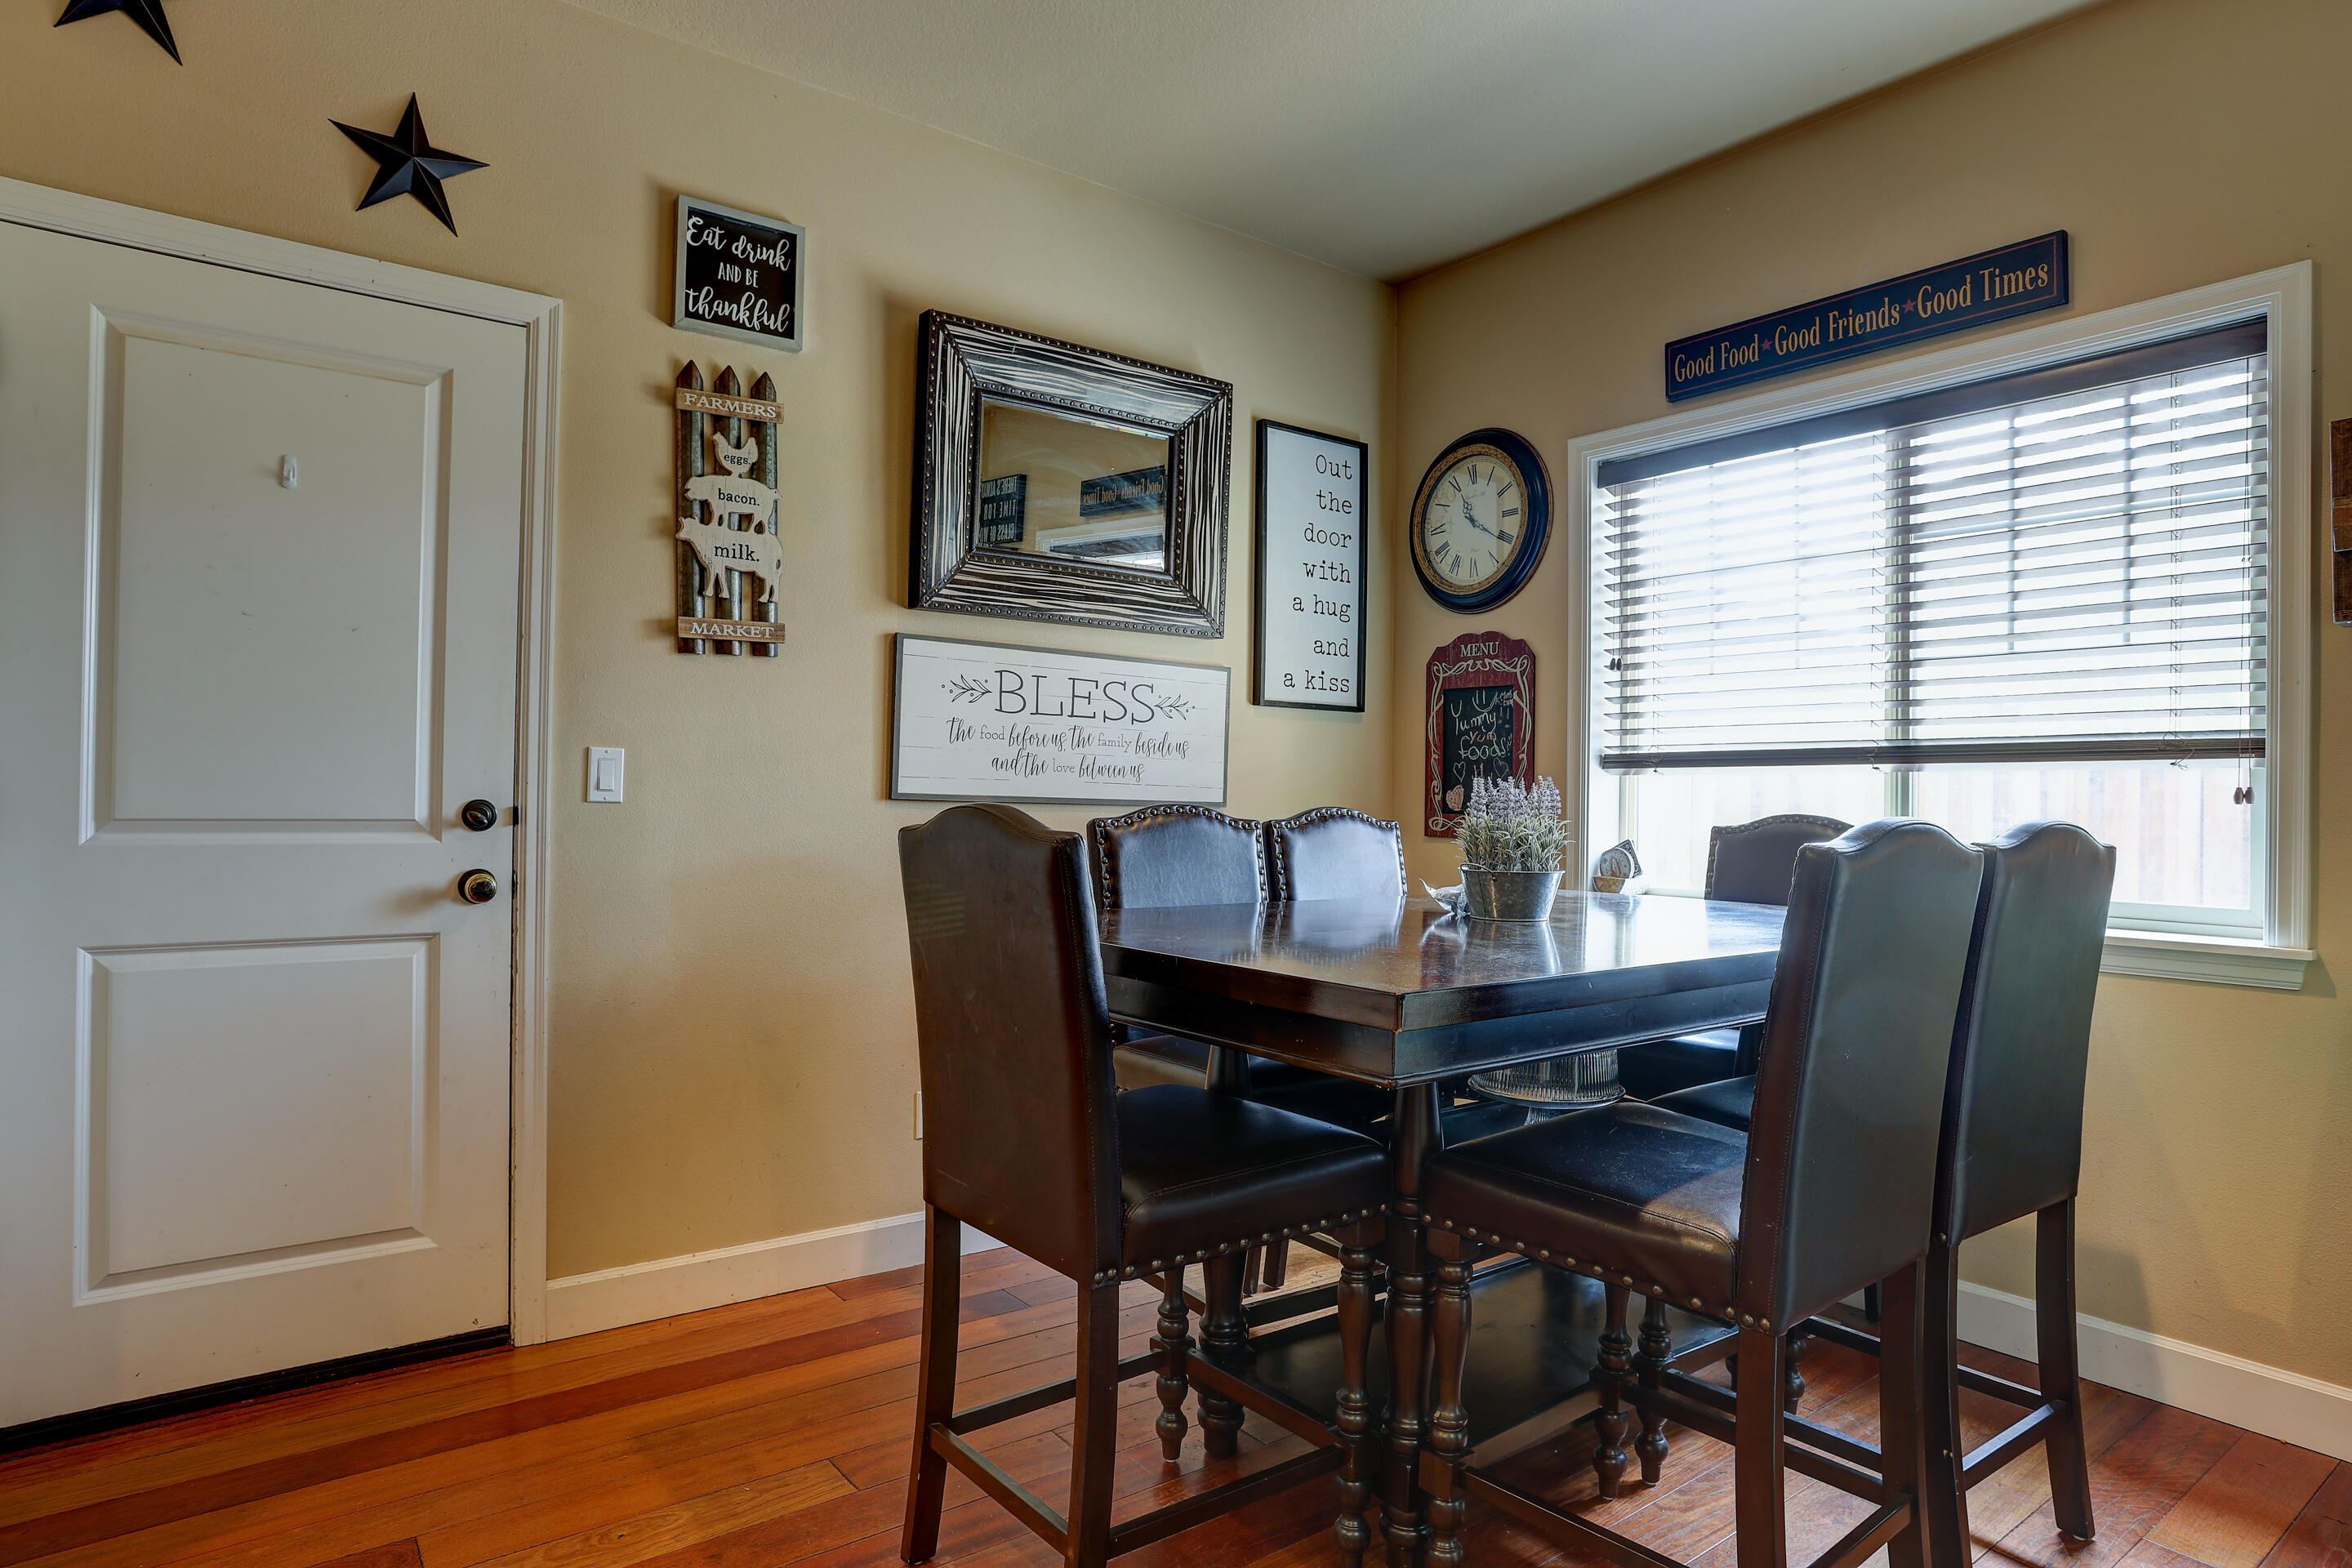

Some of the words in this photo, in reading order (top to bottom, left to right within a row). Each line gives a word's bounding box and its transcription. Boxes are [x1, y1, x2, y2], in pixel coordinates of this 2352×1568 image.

[686, 216, 727, 250] Eat
[732, 235, 791, 271] drink
[718, 262, 742, 283] AND
[746, 268, 759, 288] BE
[684, 286, 791, 332] thankful
[1674, 346, 1715, 383] Good
[1720, 333, 1759, 371] Food
[1774, 316, 1820, 355] Good
[1827, 297, 1900, 342] Friends
[1917, 275, 1972, 318] Good
[1980, 263, 2049, 301] Times
[683, 392, 777, 418] FARMERS
[724, 453, 751, 466] eggs.
[1316, 454, 1352, 480] Out
[718, 488, 760, 506] bacon.
[1316, 489, 1352, 514] the
[1303, 523, 1352, 548] door
[714, 543, 760, 562] milk.
[1303, 560, 1351, 583] with
[1292, 596, 1304, 612] a
[1313, 595, 1351, 623] hug
[689, 621, 775, 639] MARKET
[1313, 638, 1350, 657] and
[1459, 641, 1499, 657] MENU
[1283, 672, 1295, 688] a
[1304, 670, 1350, 693] kiss
[995, 670, 1156, 724] BLESS
[980, 724, 1005, 740] food
[1009, 723, 1050, 751] before
[1098, 733, 1133, 752] family
[1135, 732, 1174, 758] beside
[1175, 741, 1190, 760] us
[991, 748, 1024, 776] and
[1022, 752, 1049, 778] the
[1053, 759, 1075, 773] love
[1079, 754, 1129, 780] between
